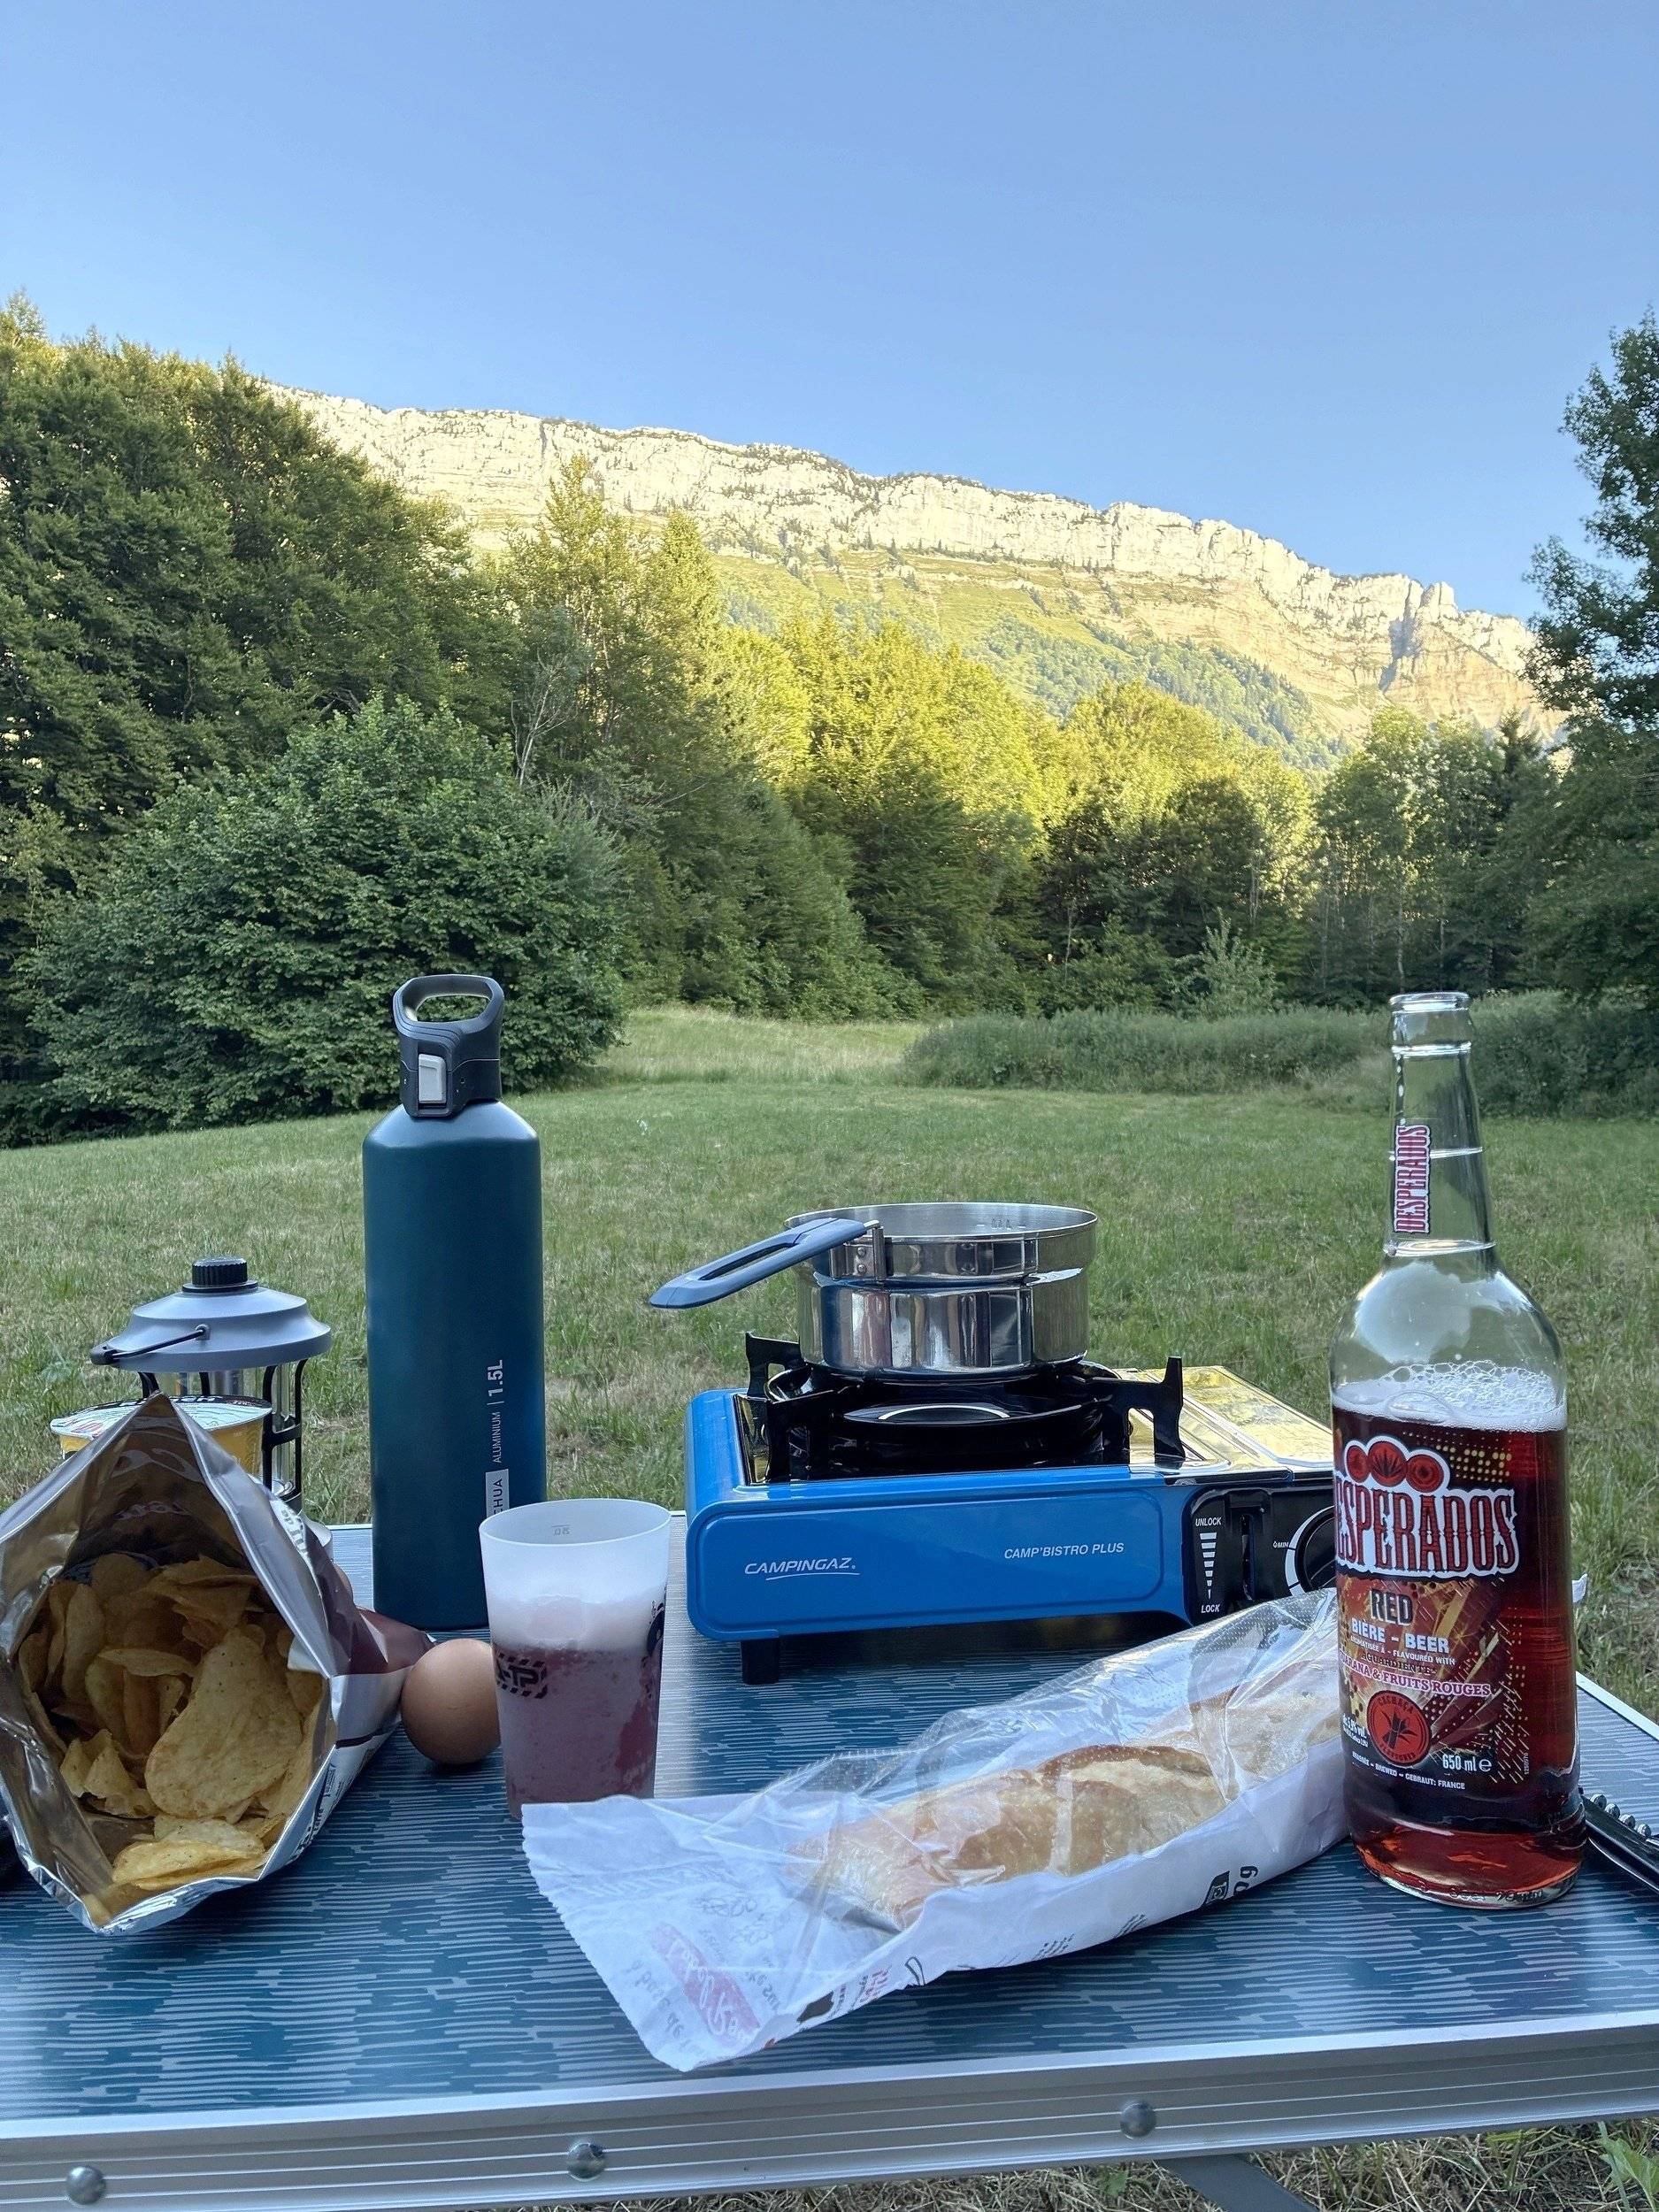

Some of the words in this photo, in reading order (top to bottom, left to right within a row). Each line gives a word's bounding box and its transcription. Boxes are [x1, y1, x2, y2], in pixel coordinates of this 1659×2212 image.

[1395, 1125, 1429, 1233] DESPERADOS
[488, 1359, 503, 1397] 1.5L
[492, 1411, 502, 1463] ALUMINIUM
[1195, 1517, 1222, 1527] UNLOCK
[1336, 1477, 1517, 1572] ESPERADOS
[1004, 1544, 1088, 1559] CAMP'BISTRO
[1092, 1542, 1125, 1555] PLUS
[1201, 1604, 1220, 1614] LOCK
[1370, 1588, 1415, 1626] RED
[1351, 1617, 1386, 1643] BIÈRE
[1405, 1632, 1450, 1654] BEER
[1393, 1649, 1433, 1663] FLAVOURED
[1435, 1656, 1456, 1666] WITH
[1382, 1672, 1430, 1691] FRUITS
[1431, 1681, 1492, 1696] ROUGES
[1442, 1754, 1461, 1770] 650
[1463, 1755, 1477, 1771] ml
[1437, 1780, 1466, 1790] FRANCE
